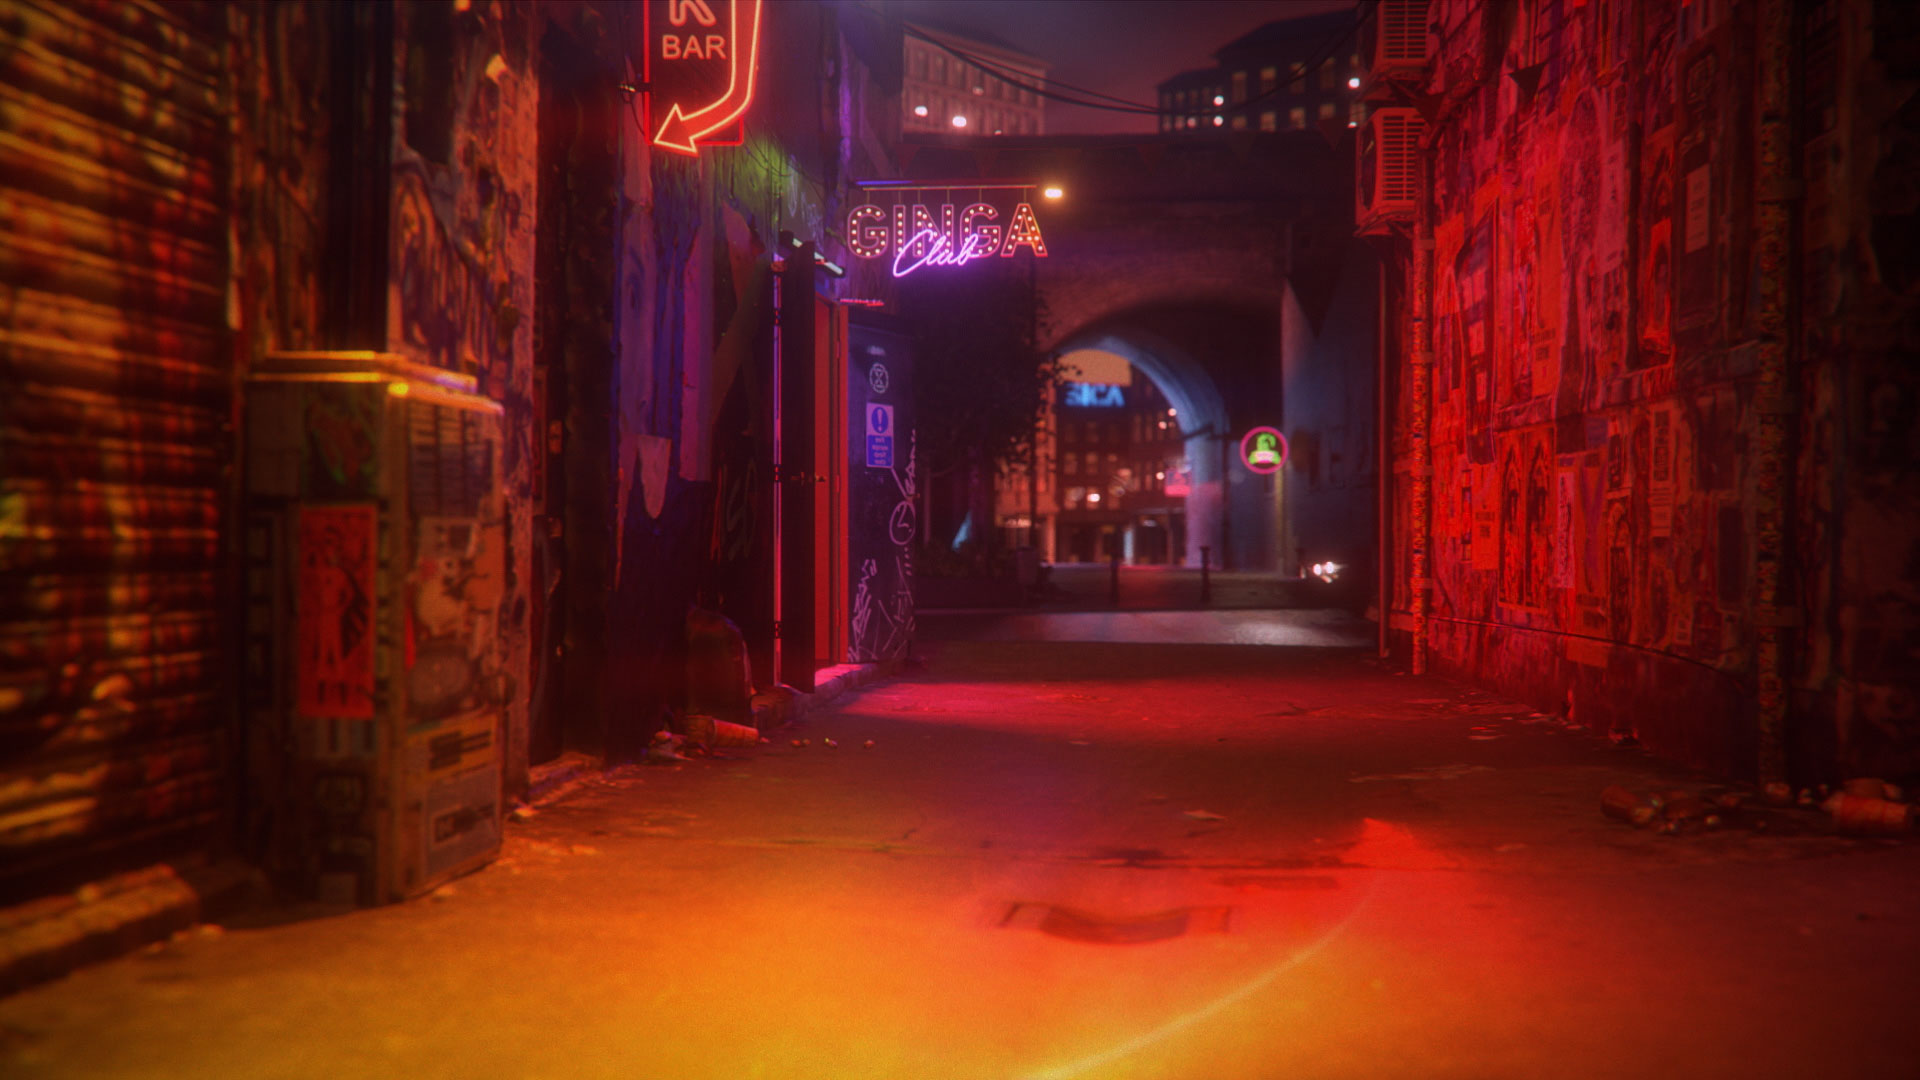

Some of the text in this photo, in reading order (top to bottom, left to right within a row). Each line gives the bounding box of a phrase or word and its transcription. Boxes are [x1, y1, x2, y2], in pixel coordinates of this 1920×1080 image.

[662, 34, 727, 60] BAR
[847, 203, 1048, 258] GINGA
[892, 228, 980, 278] Club
